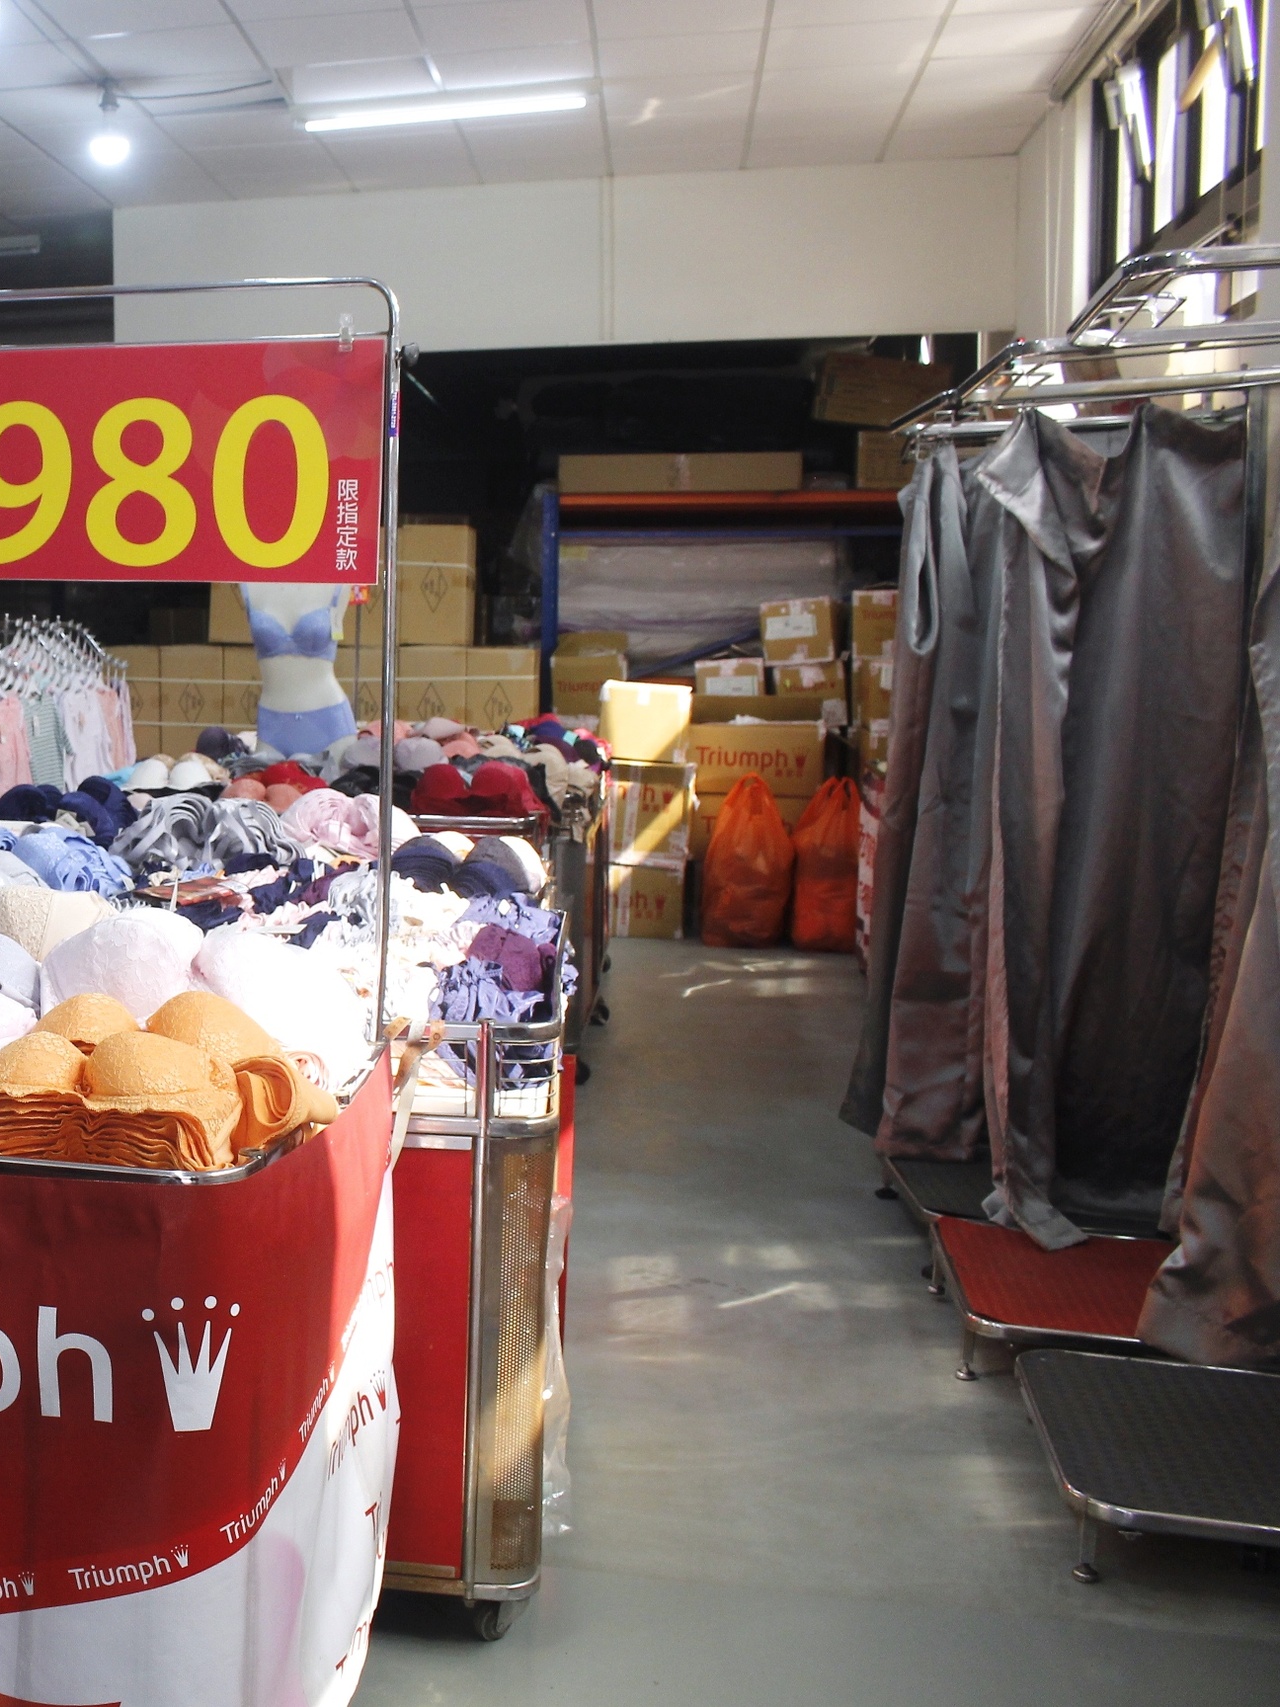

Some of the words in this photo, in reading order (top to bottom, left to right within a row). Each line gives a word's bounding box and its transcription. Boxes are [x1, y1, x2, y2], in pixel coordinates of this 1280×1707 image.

[336, 479, 359, 571] 限指定款
[696, 745, 788, 773] Triumph
[299, 1377, 329, 1442] Triumph
[220, 1477, 278, 1543] Triumph
[68, 1555, 171, 1590] Triumph
